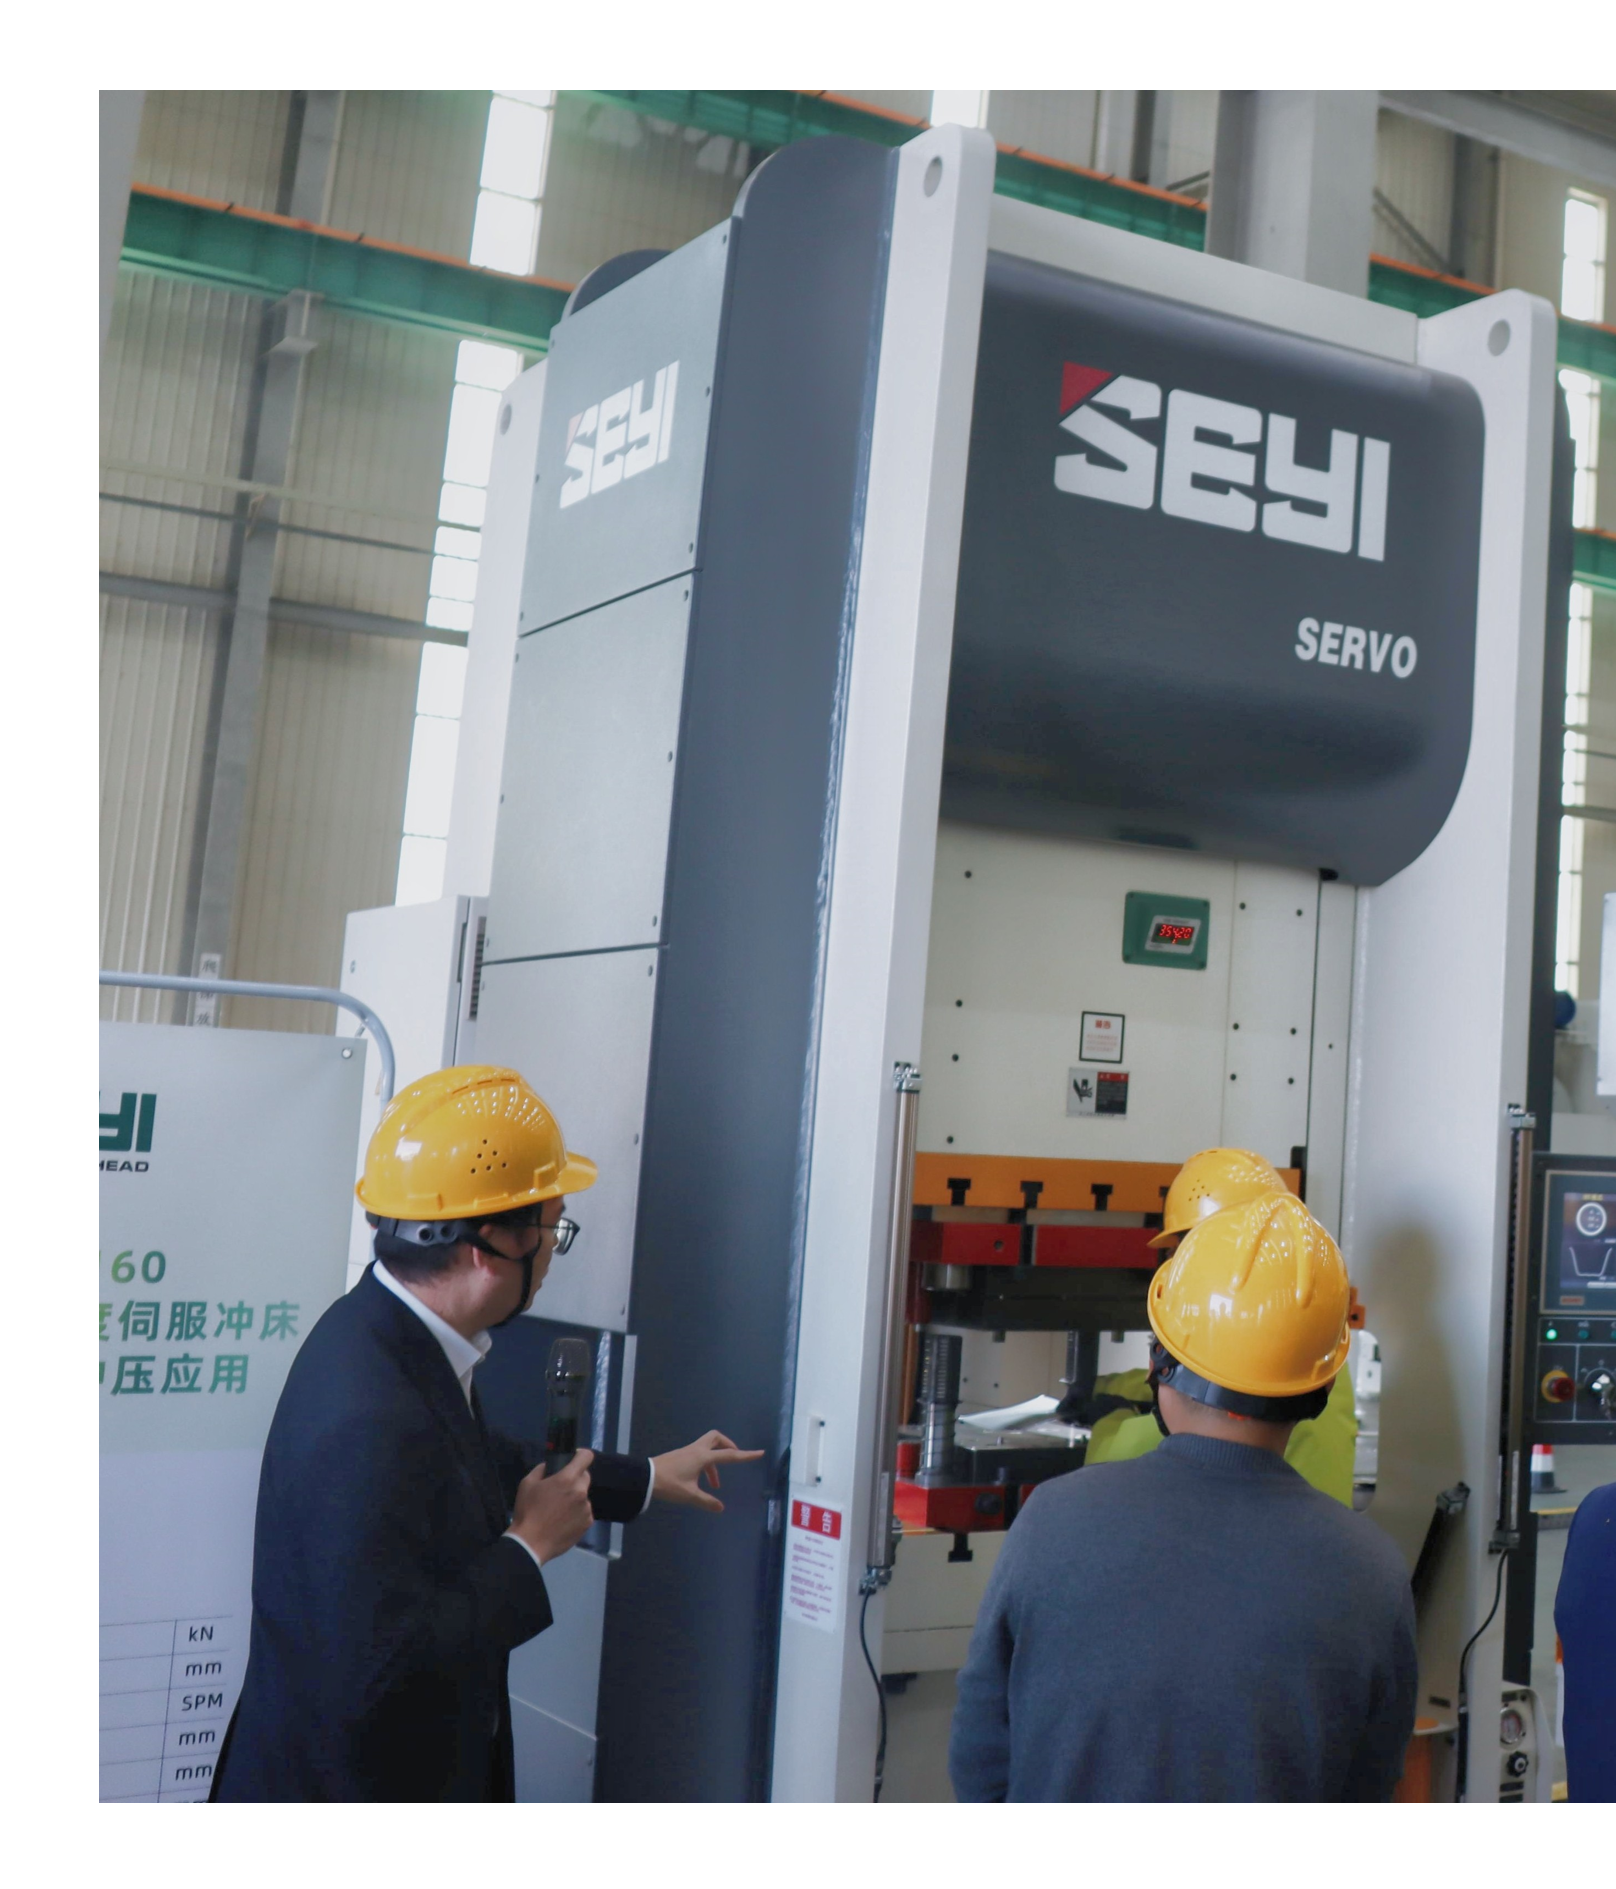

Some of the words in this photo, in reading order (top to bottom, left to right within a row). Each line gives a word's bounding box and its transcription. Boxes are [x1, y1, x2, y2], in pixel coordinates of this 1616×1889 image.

[560, 359, 680, 509] SEYI
[1054, 360, 1391, 562] SEYI
[1294, 617, 1418, 679] SERVO
[99, 1250, 166, 1284] 60
[99, 1353, 249, 1396] 压应用
[188, 1626, 214, 1642] kN
[185, 1661, 222, 1677] mm
[181, 1693, 223, 1711] SPM
[178, 1730, 216, 1746] mm
[175, 1765, 213, 1781] mm
